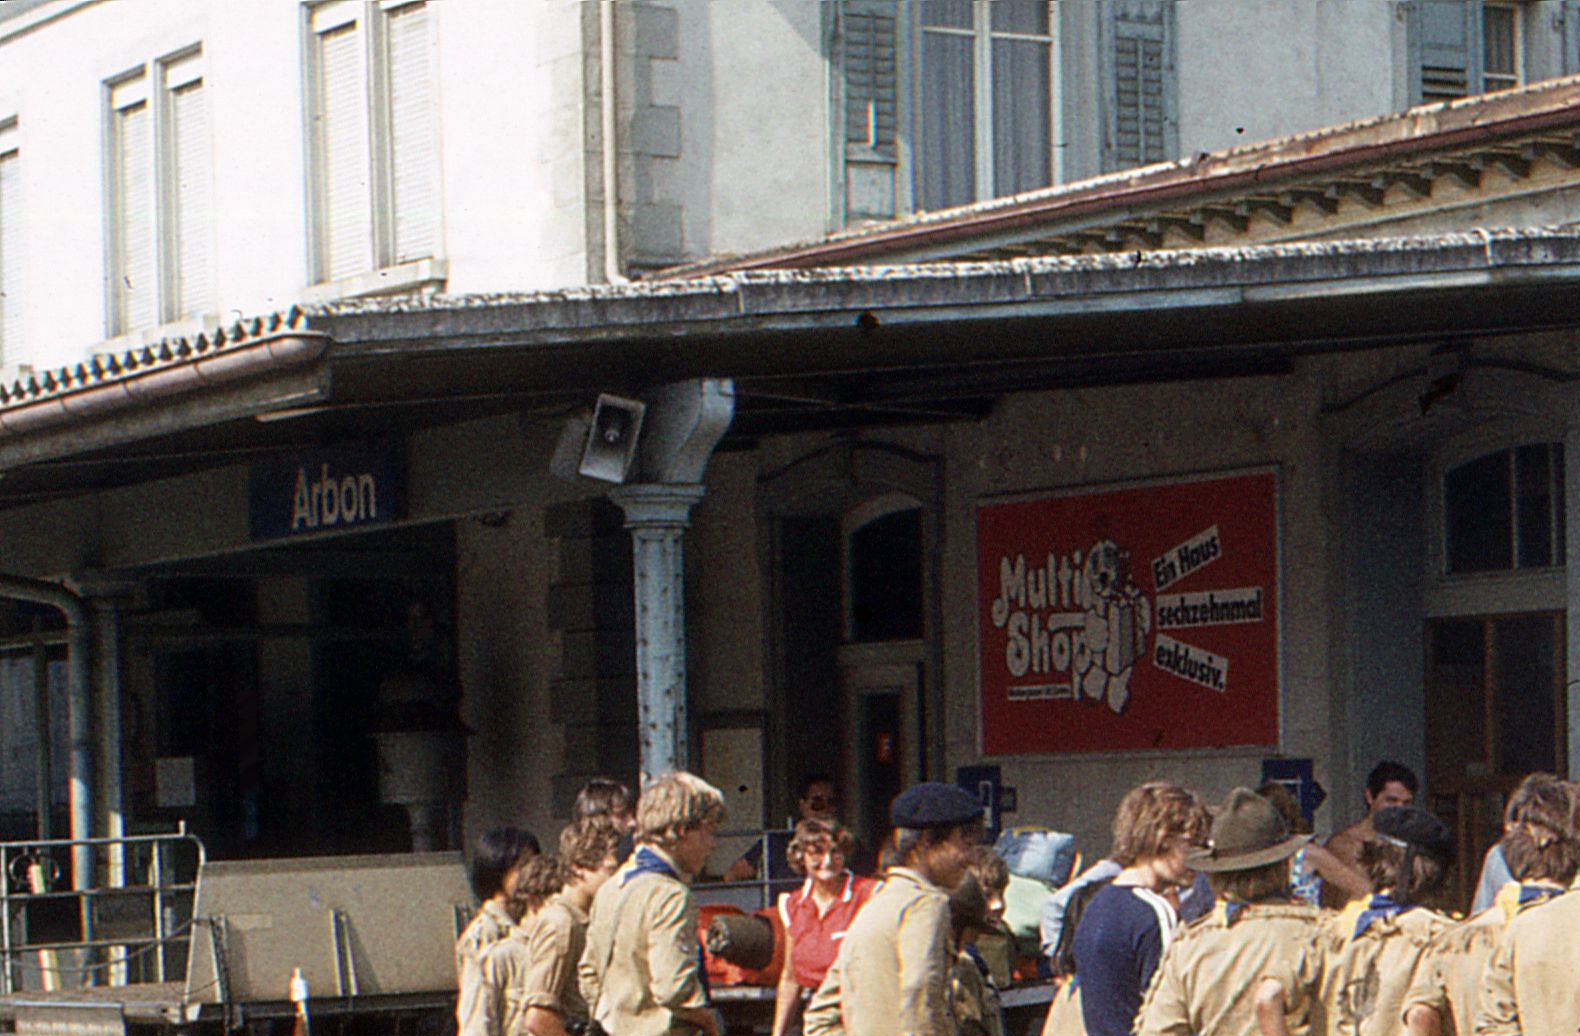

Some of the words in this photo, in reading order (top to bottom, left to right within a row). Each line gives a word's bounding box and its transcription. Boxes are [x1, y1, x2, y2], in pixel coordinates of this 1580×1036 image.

[291, 463, 376, 530] Arbon
[992, 550, 1082, 627] Multi
[1153, 557, 1177, 588] Ein
[1178, 536, 1219, 574] Haus
[1006, 611, 1092, 700] Shop
[1156, 643, 1224, 690] exklusiv.
